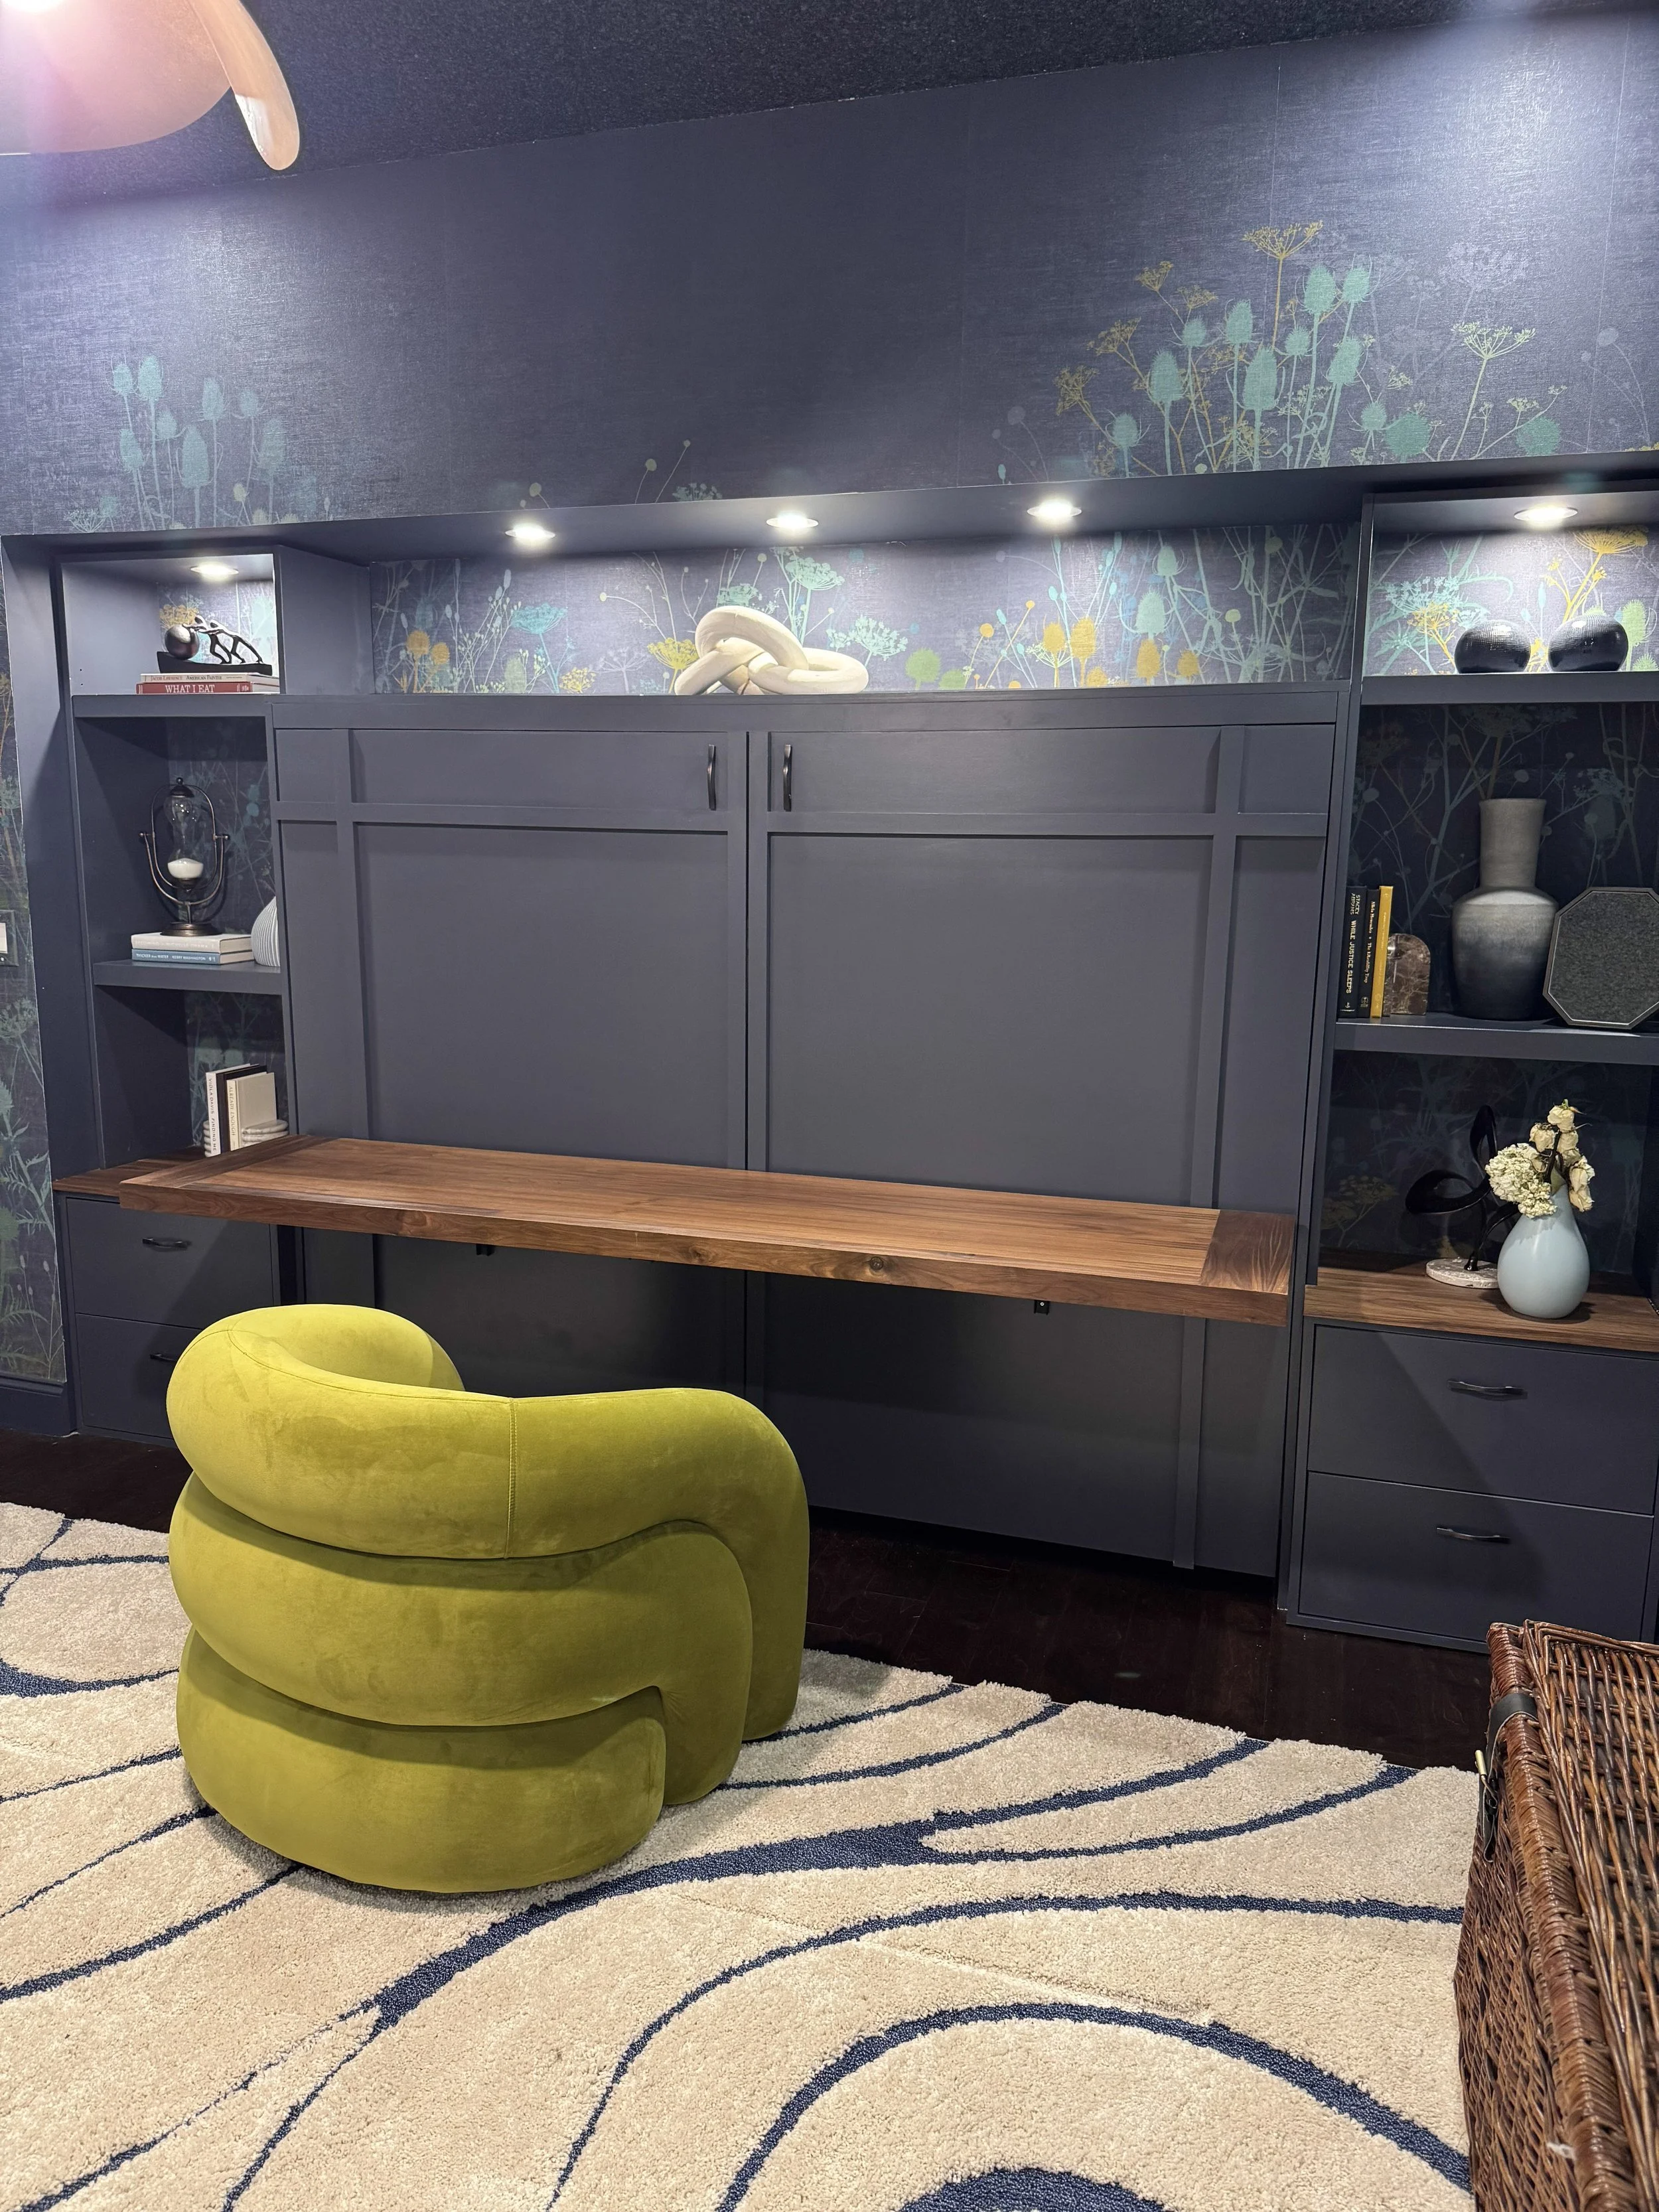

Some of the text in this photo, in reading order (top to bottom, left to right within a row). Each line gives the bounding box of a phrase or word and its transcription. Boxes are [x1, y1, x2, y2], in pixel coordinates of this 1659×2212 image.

[165, 684, 215, 693] WHAT I EAT
